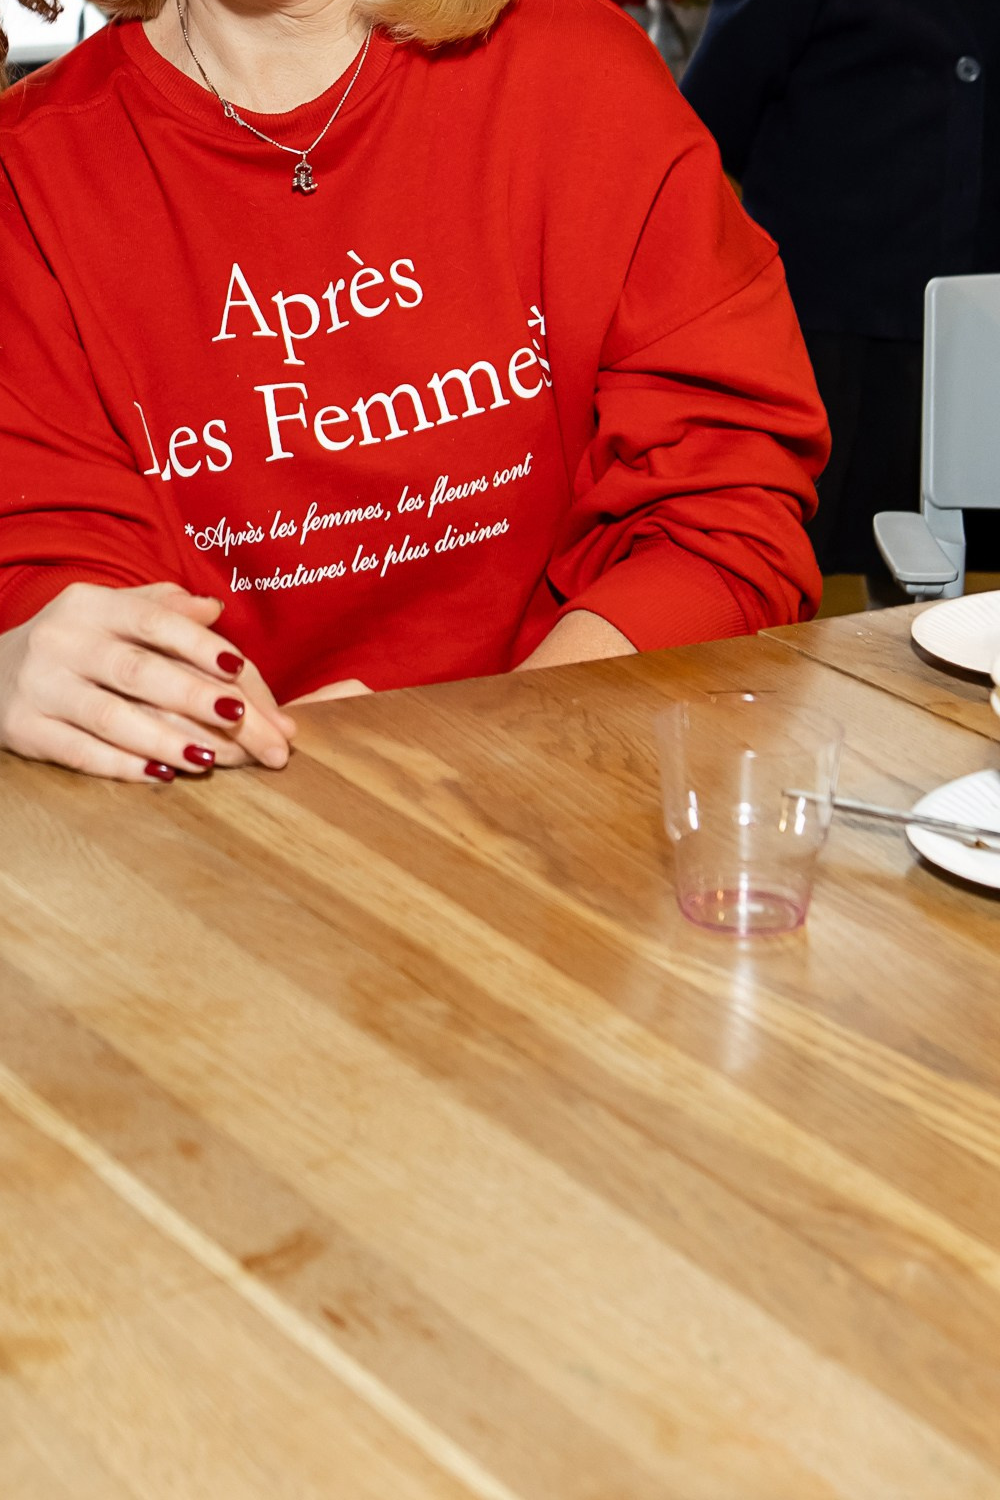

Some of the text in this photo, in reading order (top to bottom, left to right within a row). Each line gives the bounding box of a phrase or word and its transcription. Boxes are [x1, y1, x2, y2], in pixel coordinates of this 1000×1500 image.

[212, 250, 423, 365] Après
[270, 510, 297, 539] les
[300, 502, 391, 545] femmes,
[397, 486, 425, 513] les
[427, 475, 489, 518] fleurs
[493, 452, 533, 487] sont
[230, 518, 509, 592] les créatures les plus divines
